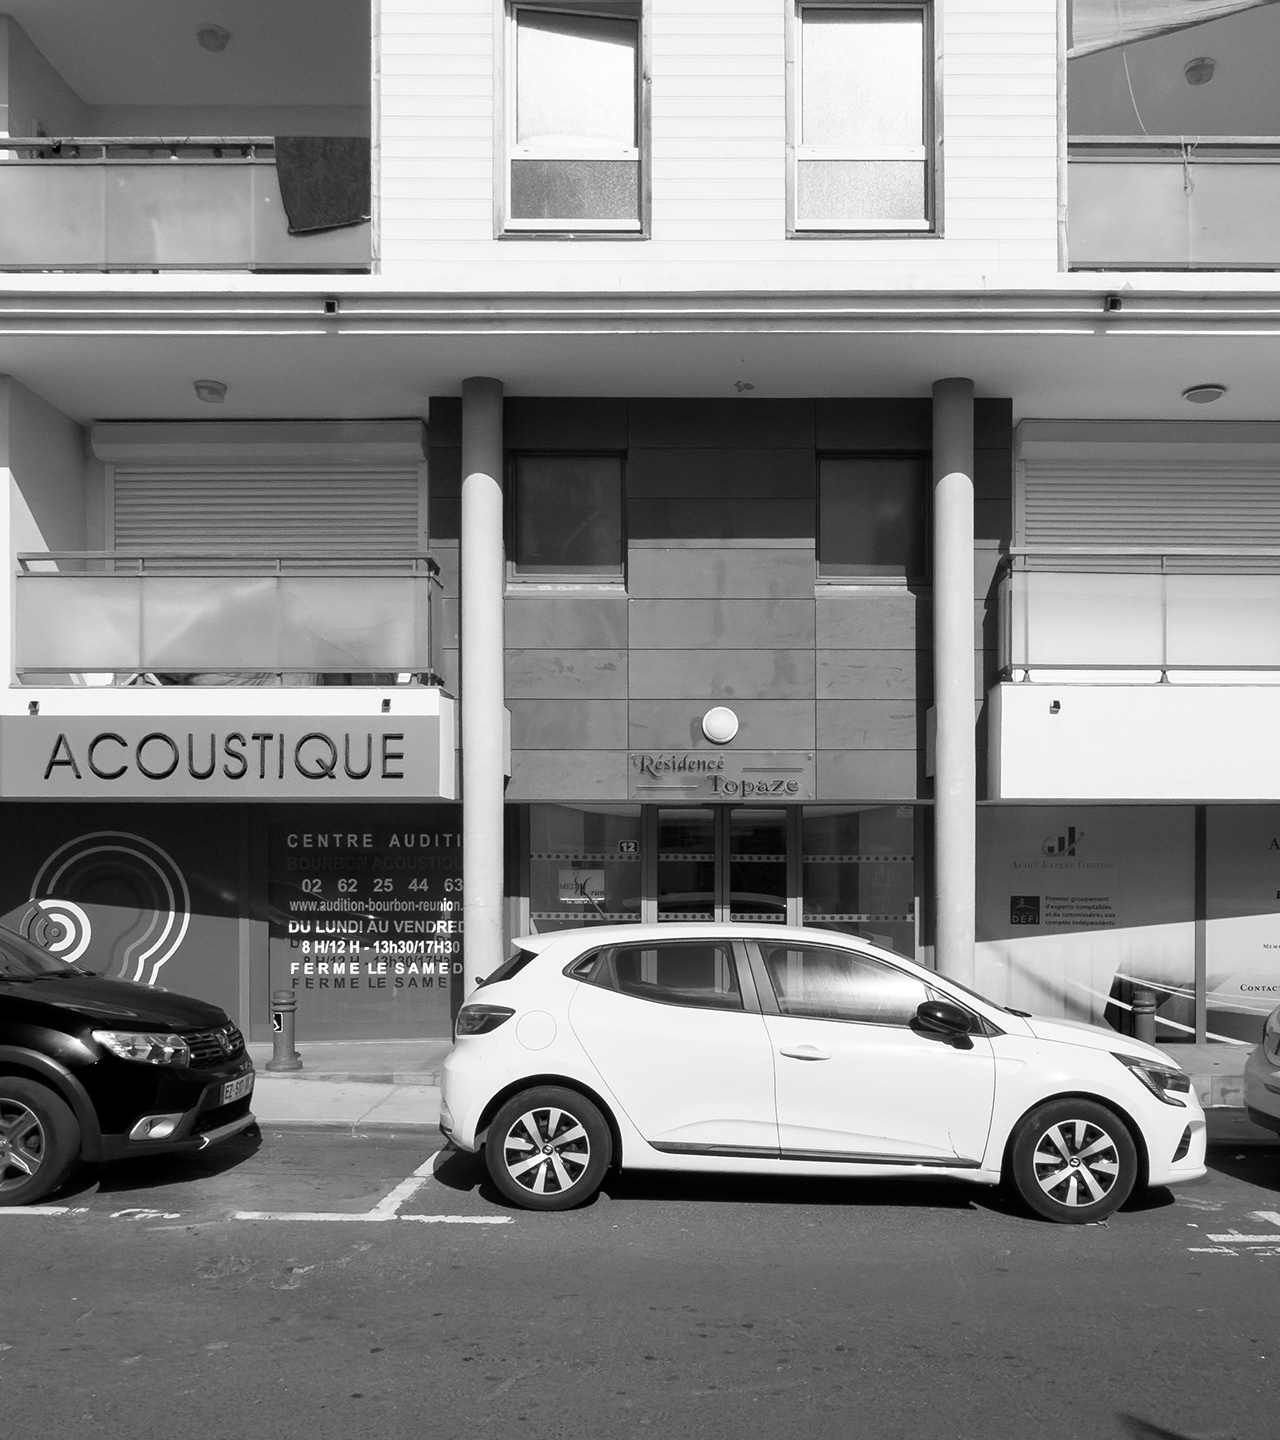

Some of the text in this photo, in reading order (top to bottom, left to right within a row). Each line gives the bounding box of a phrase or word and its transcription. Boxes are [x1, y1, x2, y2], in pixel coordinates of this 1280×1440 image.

[44, 732, 405, 780] ACOUSTIQUE
[633, 754, 725, 780] Résidence
[706, 774, 800, 798] Topaze
[287, 834, 464, 847] CENTRE AUDITI
[621, 842, 635, 852] 12
[372, 857, 464, 871] ACOUSTIQU
[301, 879, 463, 893] 02 62 25 44 63
[290, 897, 465, 912] www.audition-bourbon-reunion.
[1012, 915, 1039, 923] DEFI
[288, 920, 464, 934] DU LUNDI AU VENDRED
[301, 940, 311, 954] 8
[314, 940, 346, 954] H/12
[349, 940, 360, 954] H
[373, 940, 460, 954] 13h30/17H30
[291, 962, 463, 975] FERME LE SAMED
